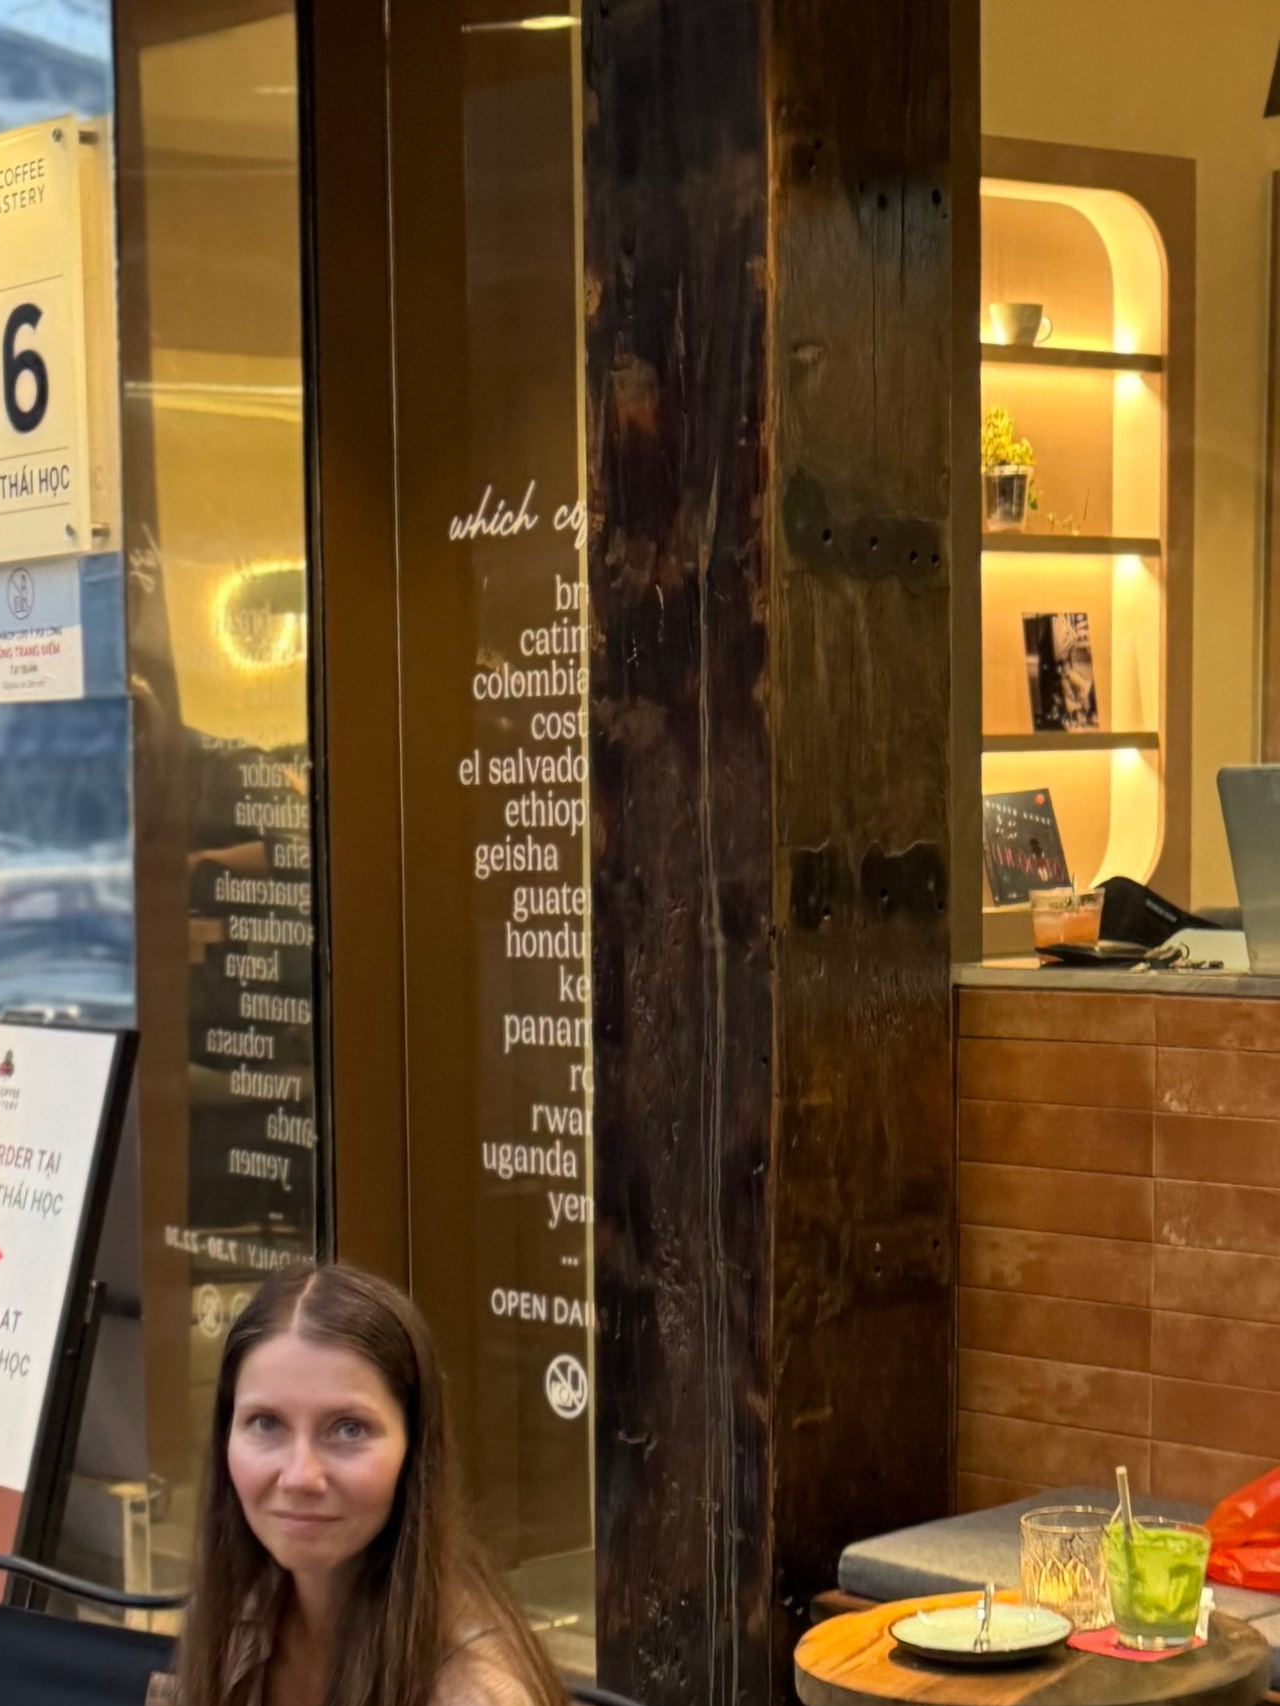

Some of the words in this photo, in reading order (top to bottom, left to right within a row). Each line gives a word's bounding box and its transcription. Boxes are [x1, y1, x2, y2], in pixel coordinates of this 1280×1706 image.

[0, 465, 33, 499] THÁI
[38, 465, 70, 497] HỌC
[449, 479, 539, 541] which
[531, 707, 588, 740] cost
[459, 749, 480, 785] el
[488, 746, 589, 784] salvado
[505, 790, 588, 836] ethiop
[475, 834, 559, 879] geisha
[513, 882, 590, 922] guate
[505, 921, 587, 959] hondu
[559, 964, 591, 1003] ke
[38, 1149, 62, 1178] TẠI
[482, 1140, 577, 1179] uganda
[30, 1188, 63, 1219] HỌC
[0, 1308, 22, 1334] AT
[491, 1288, 546, 1321] OPEN
